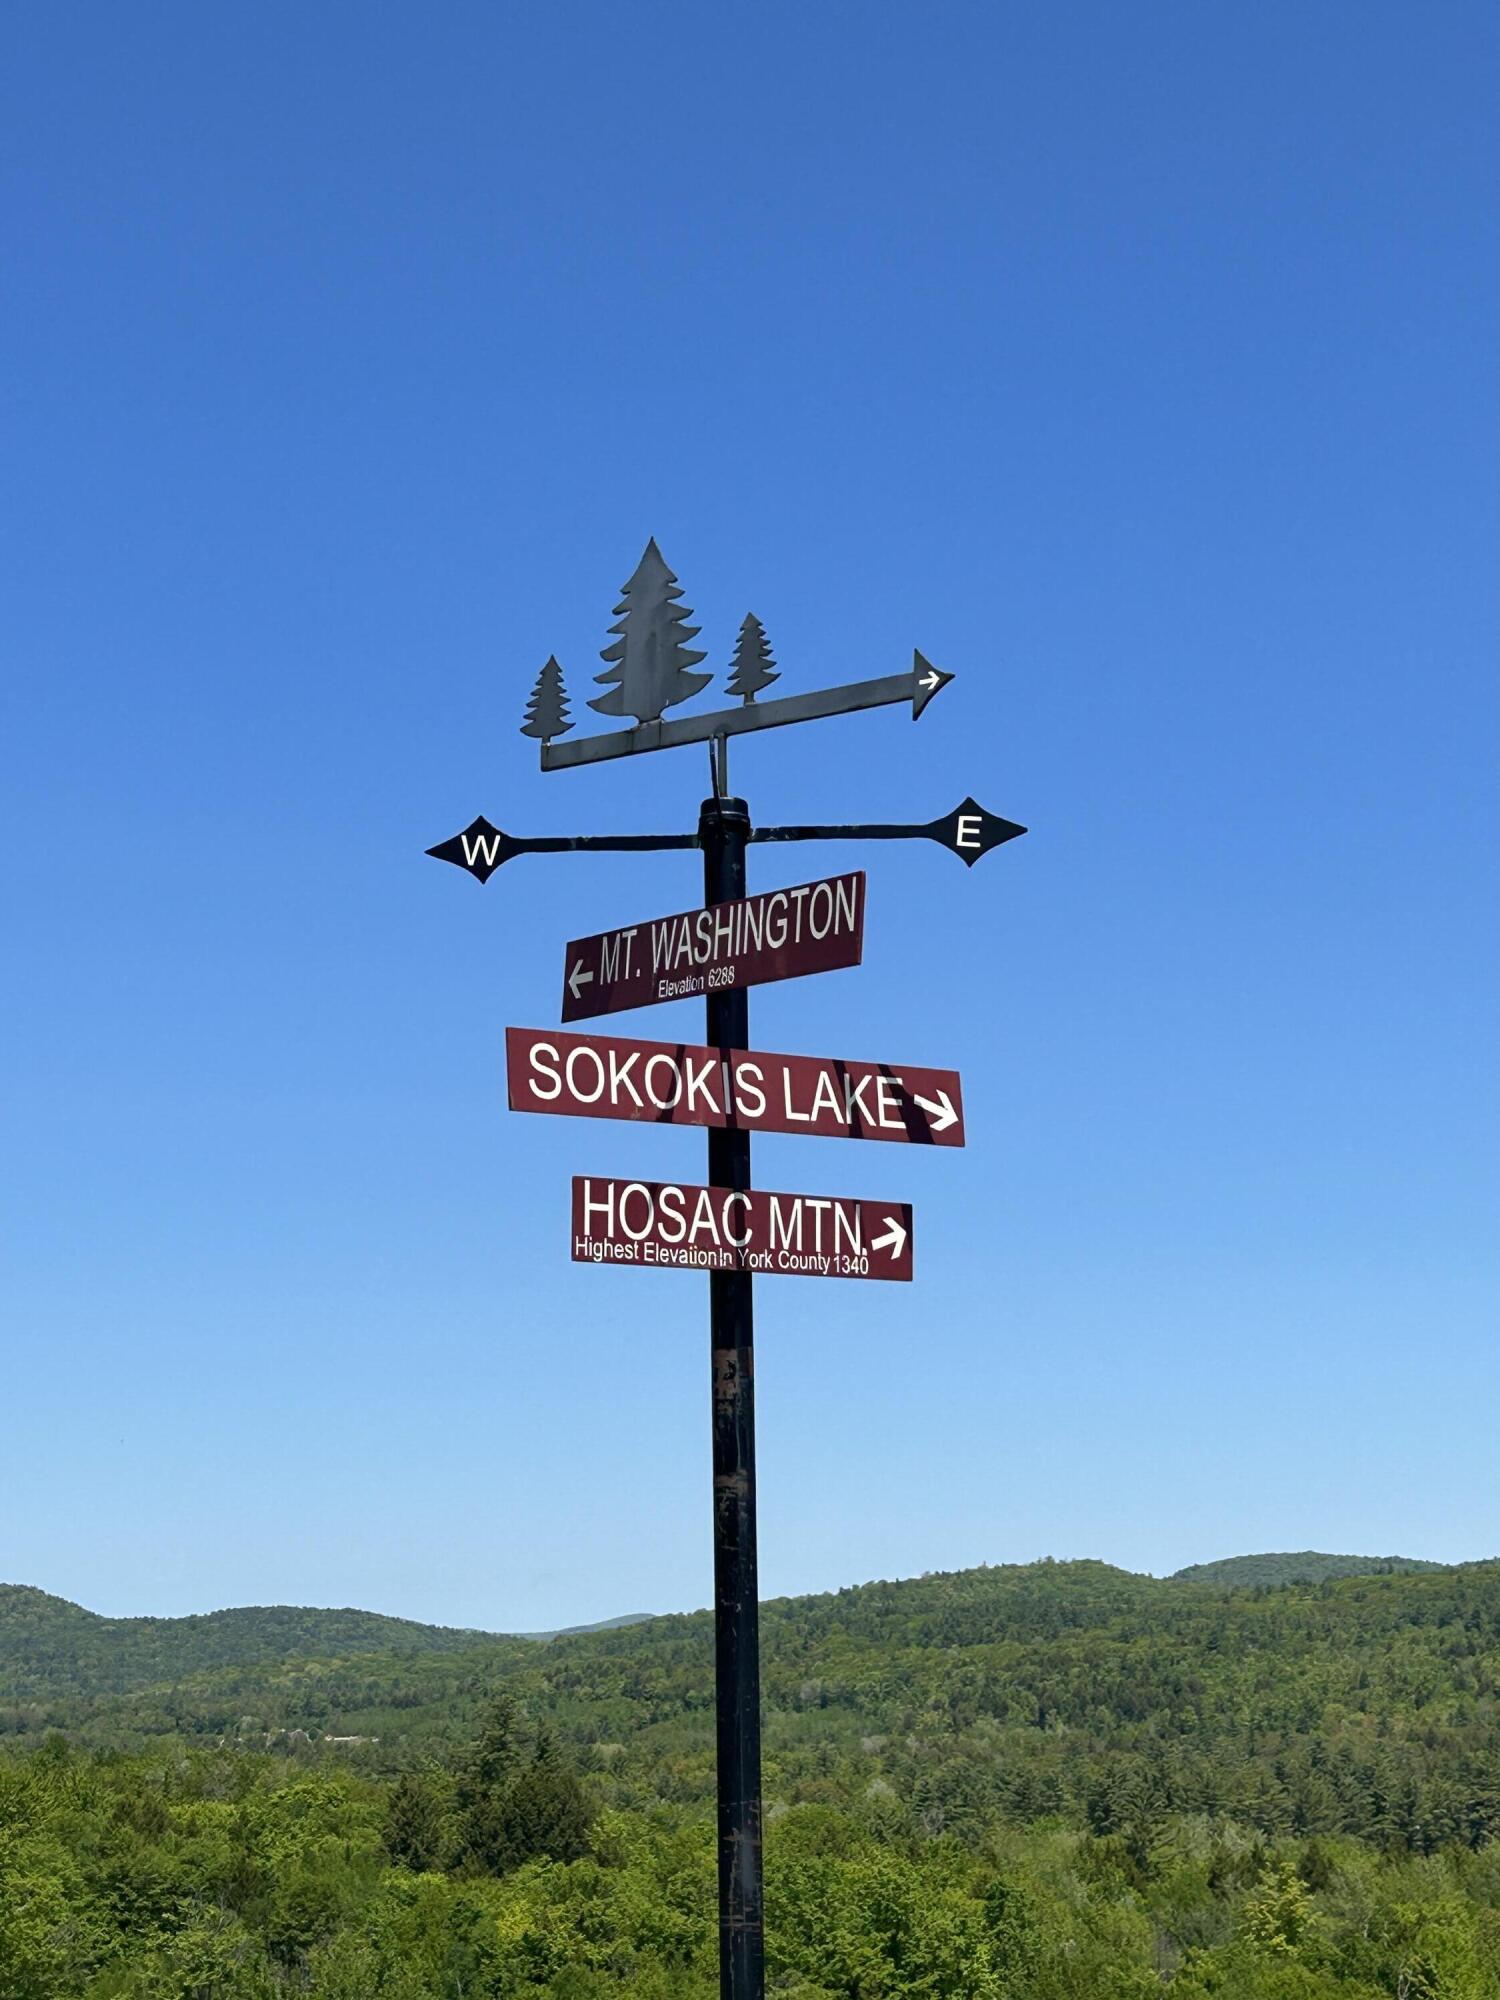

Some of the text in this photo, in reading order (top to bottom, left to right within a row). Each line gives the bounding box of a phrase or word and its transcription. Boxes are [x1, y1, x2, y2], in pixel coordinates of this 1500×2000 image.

[461, 835, 501, 866] W
[956, 815, 982, 847] E
[600, 876, 857, 985] MT. WASHINGTON
[658, 965, 735, 998] Elevation 6288
[528, 1042, 907, 1129] SOKOKIS LAKE
[583, 1179, 868, 1256] HOSAC MTN.
[575, 1236, 639, 1262] Highest
[737, 1248, 773, 1270] York
[778, 1250, 830, 1275] County
[833, 1256, 869, 1275] 1340
